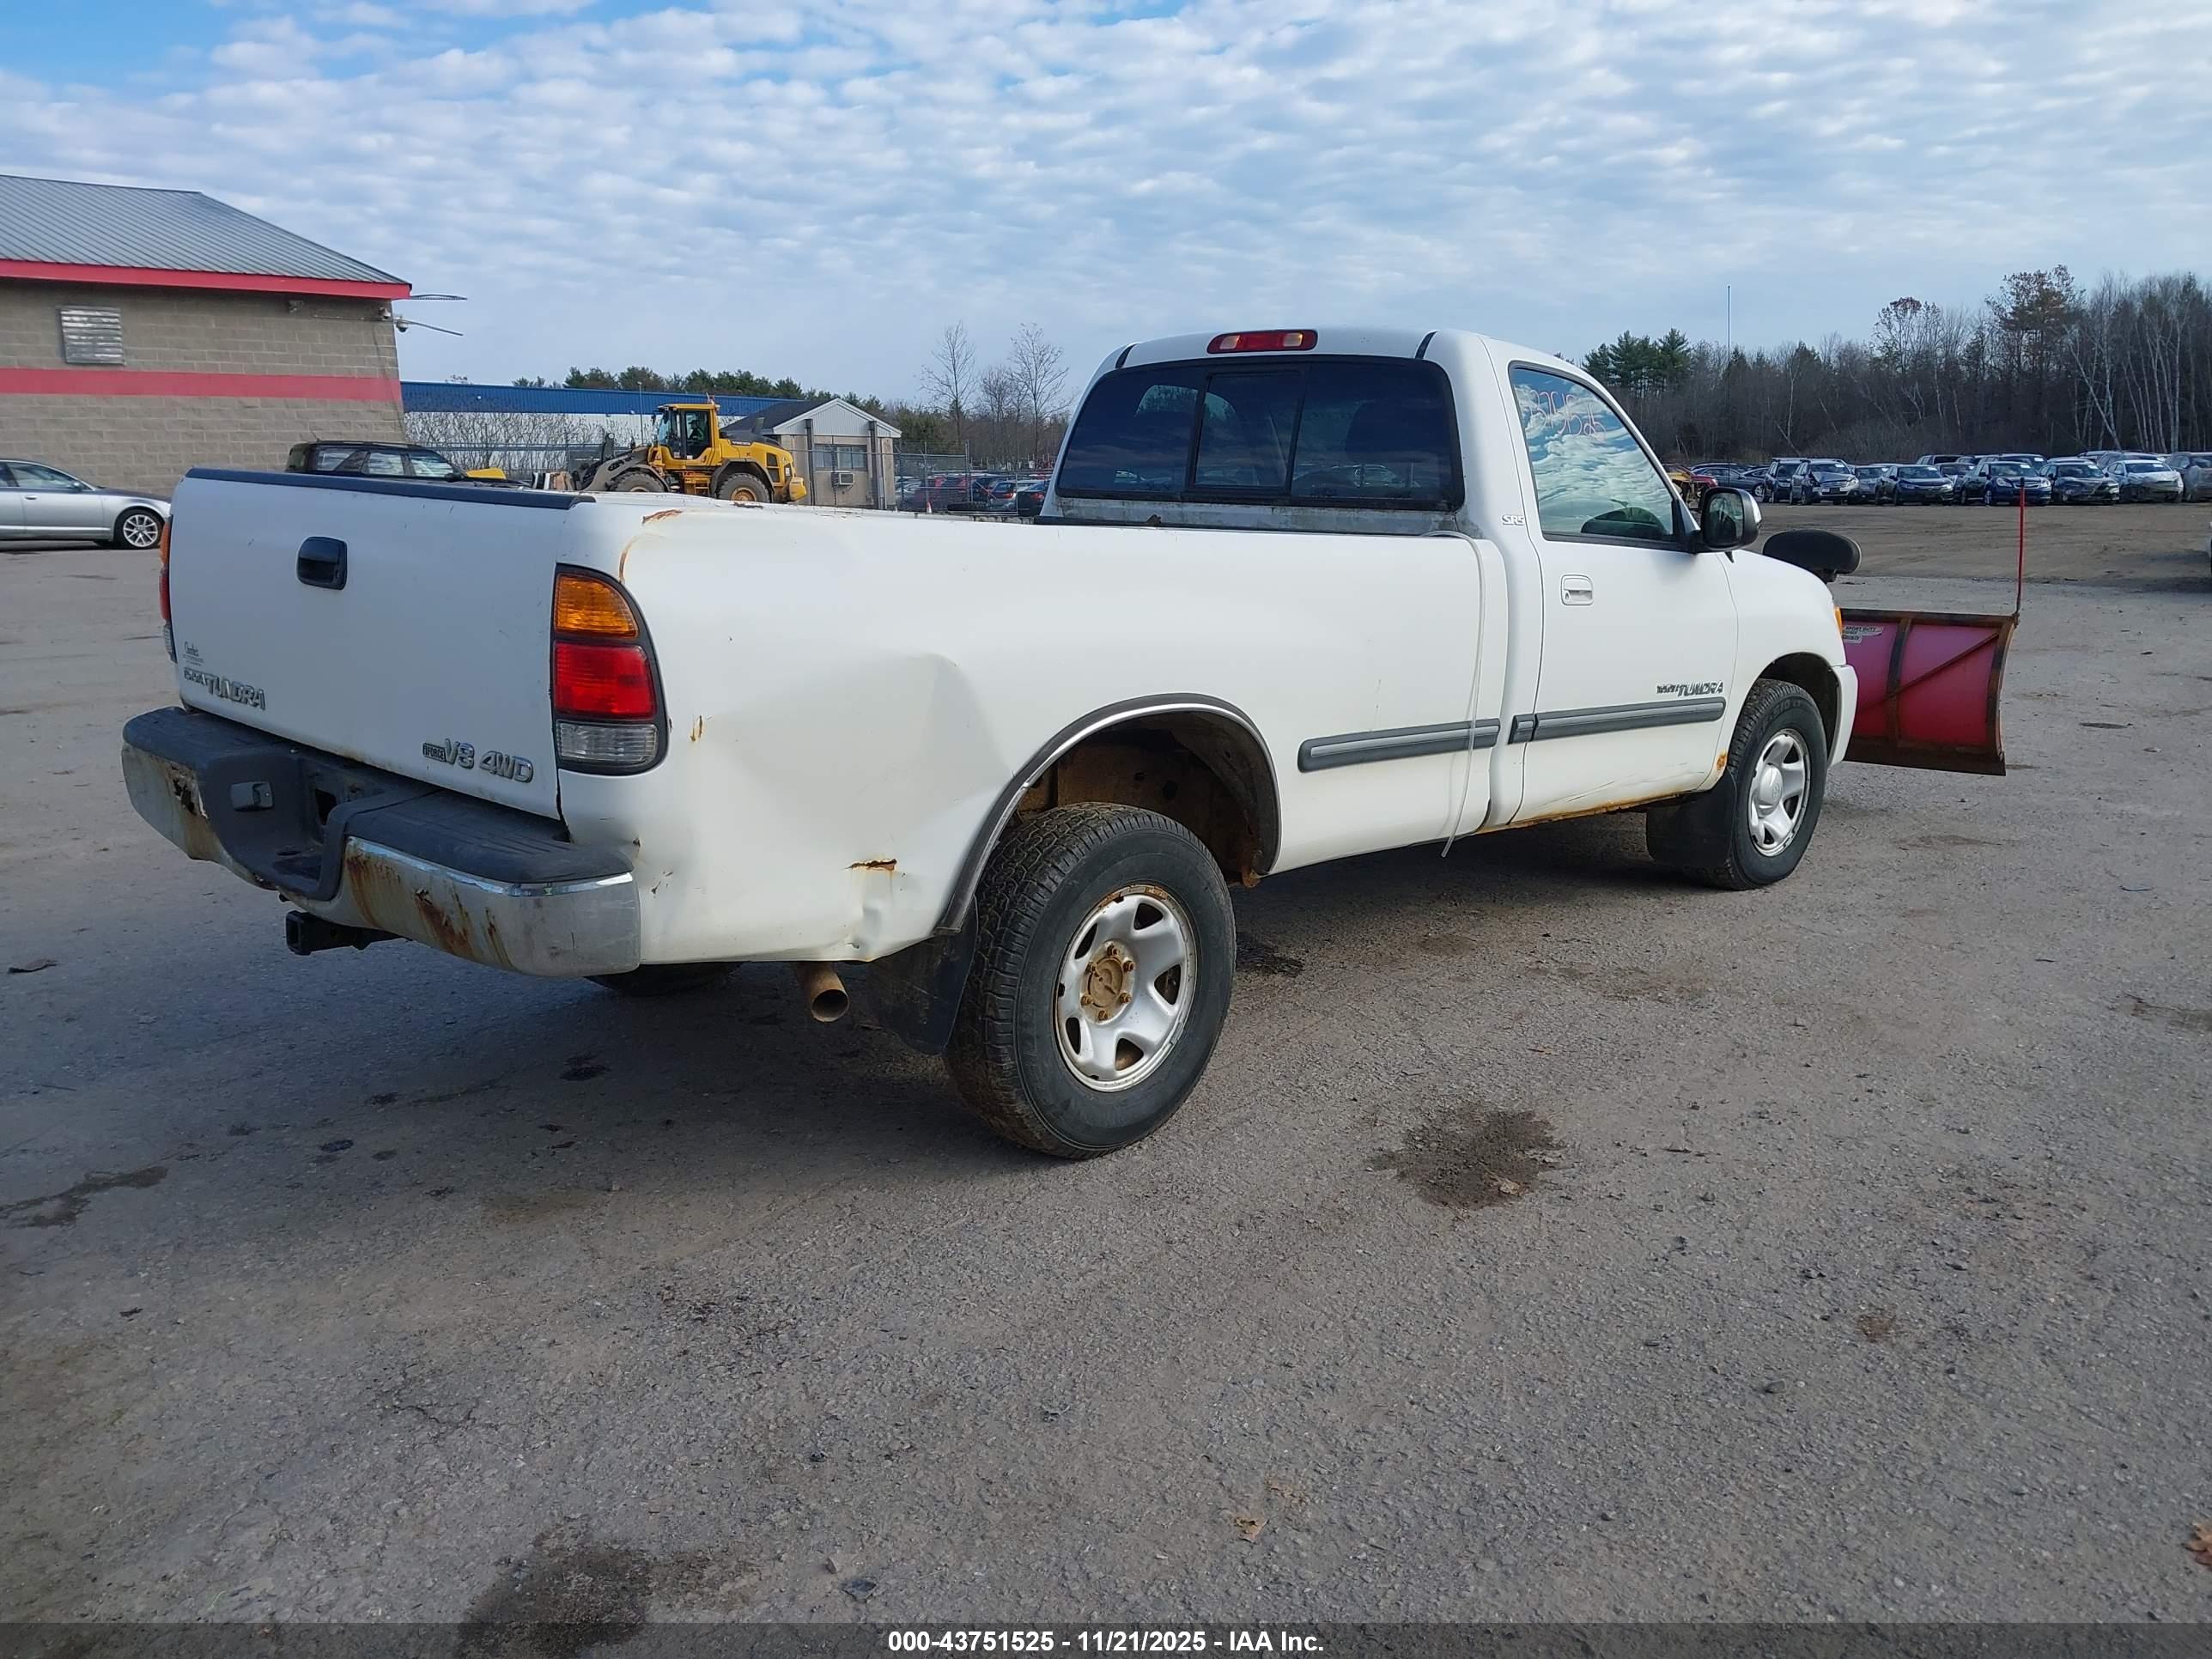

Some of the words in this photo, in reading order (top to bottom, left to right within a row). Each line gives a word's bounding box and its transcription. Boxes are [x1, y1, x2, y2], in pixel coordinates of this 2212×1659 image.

[1501, 514, 1526, 526] SR5
[204, 672, 266, 711] TUNDRA
[1676, 681, 1724, 697] TUNDRA
[445, 738, 475, 769] V8
[479, 750, 534, 783] 4WD
